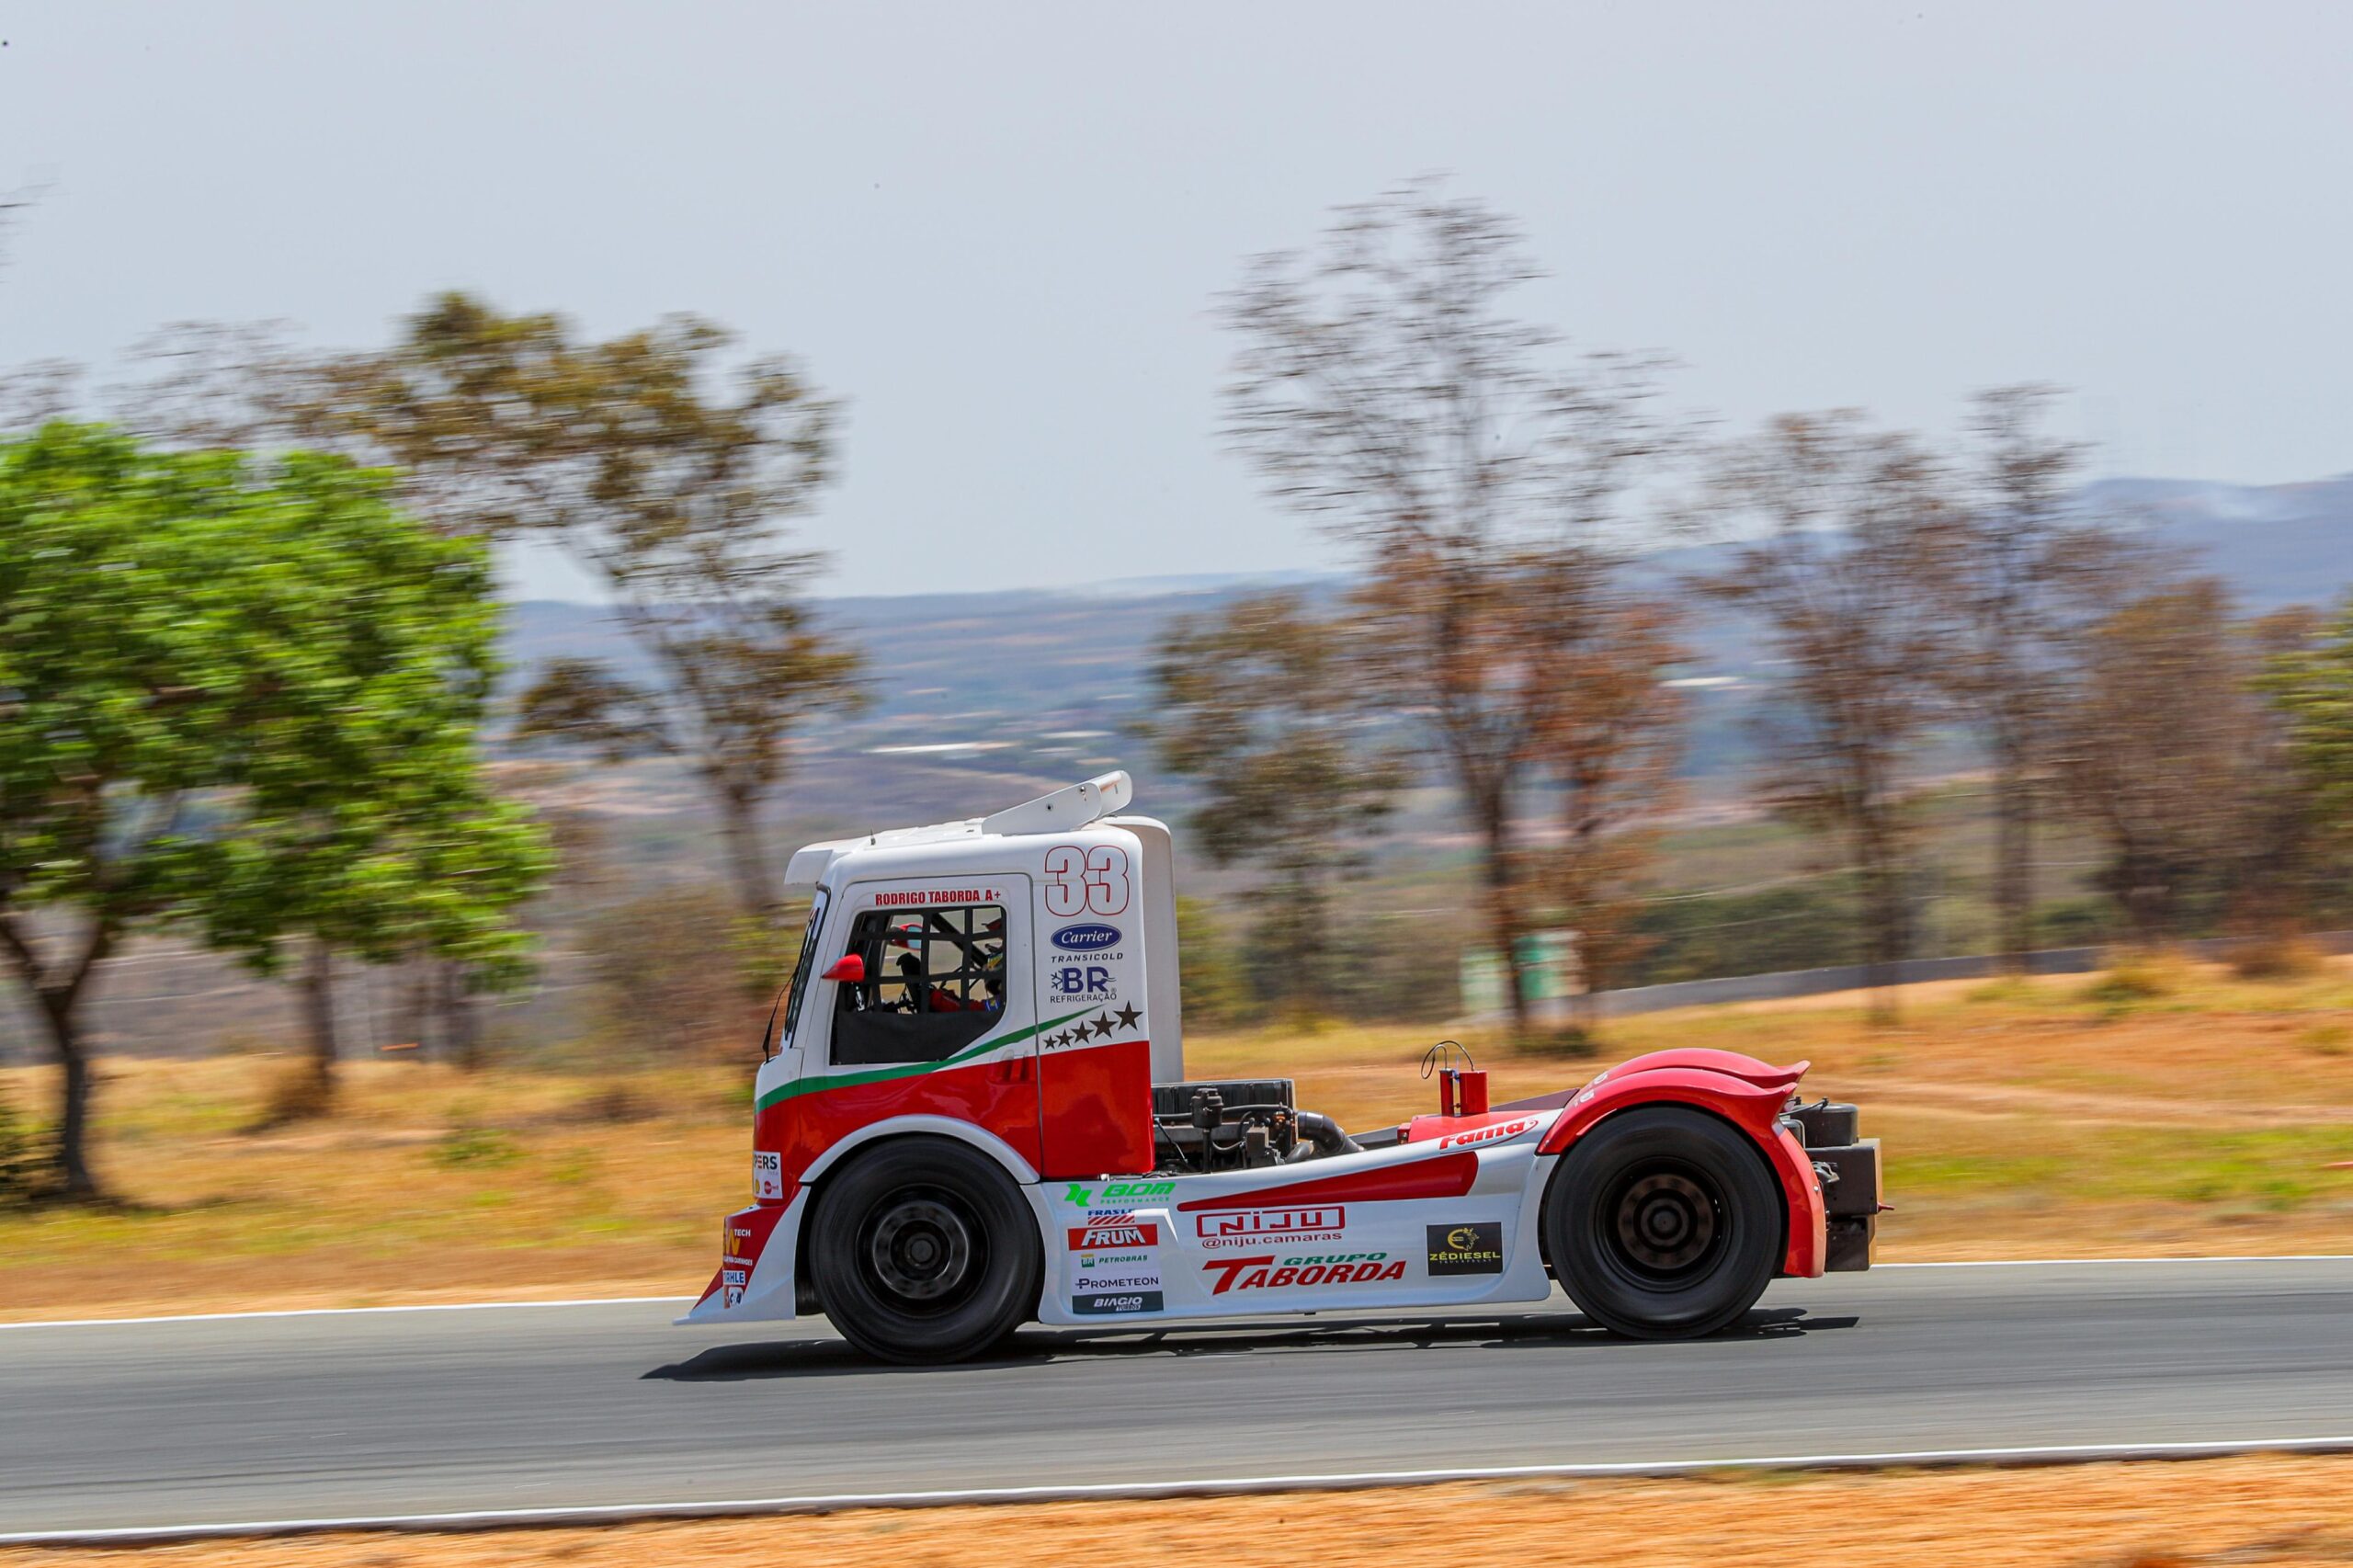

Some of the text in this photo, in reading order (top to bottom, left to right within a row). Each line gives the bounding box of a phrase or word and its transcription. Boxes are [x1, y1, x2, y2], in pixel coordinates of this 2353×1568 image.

[1044, 845, 1130, 917] 33
[875, 892, 926, 906] RODRIGO
[928, 890, 981, 903] TABORDA
[1061, 929, 1113, 944] Carrier
[1051, 952, 1124, 963] TRANSICOLD
[1062, 966, 1111, 994] BR
[1050, 992, 1118, 1004] REFRIGERAÇÃO
[734, 1229, 752, 1238] TECH
[1081, 1226, 1146, 1247] FRUM
[1201, 1231, 1343, 1249] @niju.camaras
[1098, 1255, 1148, 1264] PETROBRAS
[1283, 1252, 1388, 1267] GRUPO
[1429, 1251, 1501, 1261] ZÉDIESEL
[1201, 1255, 1407, 1296] TABORDA
[1076, 1277, 1159, 1290] PROMETEON
[1094, 1296, 1143, 1308] BIAGIO
